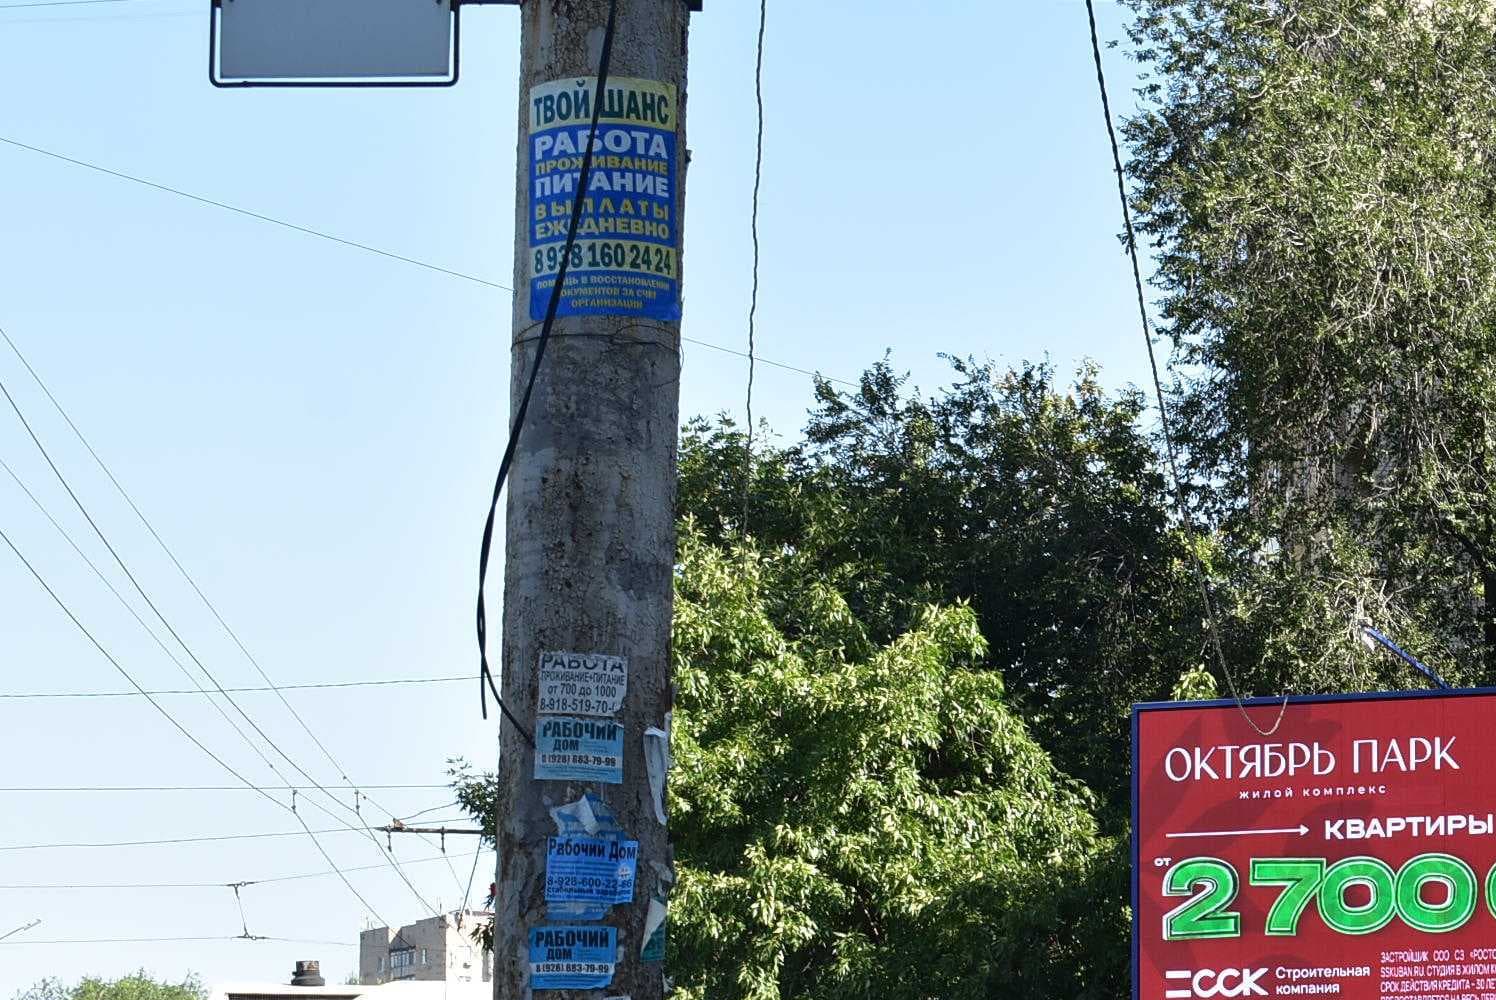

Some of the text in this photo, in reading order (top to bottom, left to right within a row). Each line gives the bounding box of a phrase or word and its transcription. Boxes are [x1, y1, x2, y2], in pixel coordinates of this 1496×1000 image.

[534, 80, 669, 126] ТВОЙ ШАНС
[535, 129, 668, 160] РАБОТА
[536, 217, 669, 240] ЕЖДНЕВНО
[534, 249, 543, 274] 8
[588, 242, 626, 268] 160
[629, 245, 652, 271] 24
[654, 249, 672, 276] 24
[560, 683, 576, 696] 700
[596, 685, 616, 698] 1000
[542, 721, 617, 741] РАБОЧИЙ
[553, 739, 579, 752] ДОМ
[1164, 736, 1461, 782] ОКТЯБРЬ ПАРК
[1239, 784, 1387, 800] жилой комплекс
[1324, 814, 1494, 840] КВАРТИРЫ
[609, 840, 636, 863] Дом
[1162, 857, 1241, 940] 2
[1250, 853, 1479, 936] 700
[535, 928, 609, 948] РАБОЧИЙ
[546, 948, 573, 961] ДОМ
[1433, 949, 1450, 962] ООО
[1276, 966, 1371, 980] Строительная
[1276, 981, 1340, 995] компания
[1380, 980, 1399, 993] СРОК
